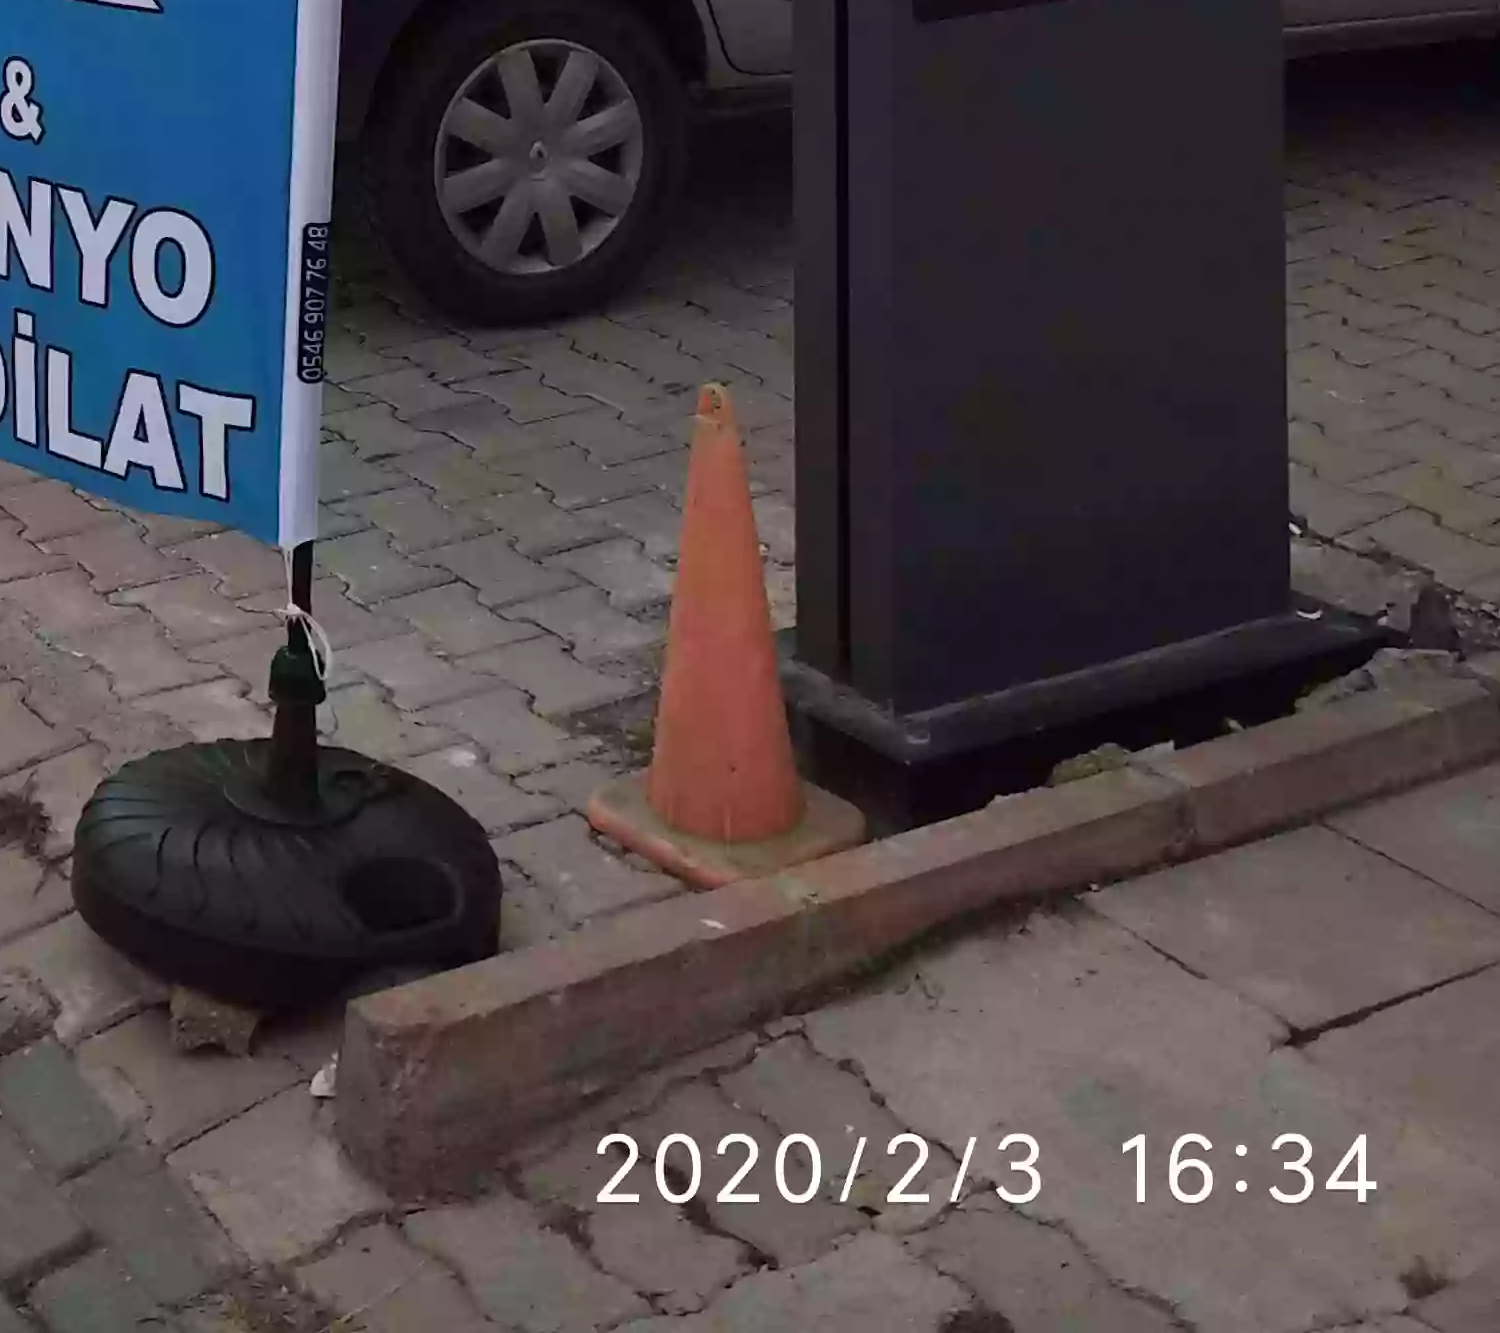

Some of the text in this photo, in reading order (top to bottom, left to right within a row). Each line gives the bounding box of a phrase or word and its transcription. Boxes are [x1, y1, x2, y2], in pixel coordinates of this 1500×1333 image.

[0, 55, 46, 145] &
[301, 225, 329, 381] 0546 907 76 48
